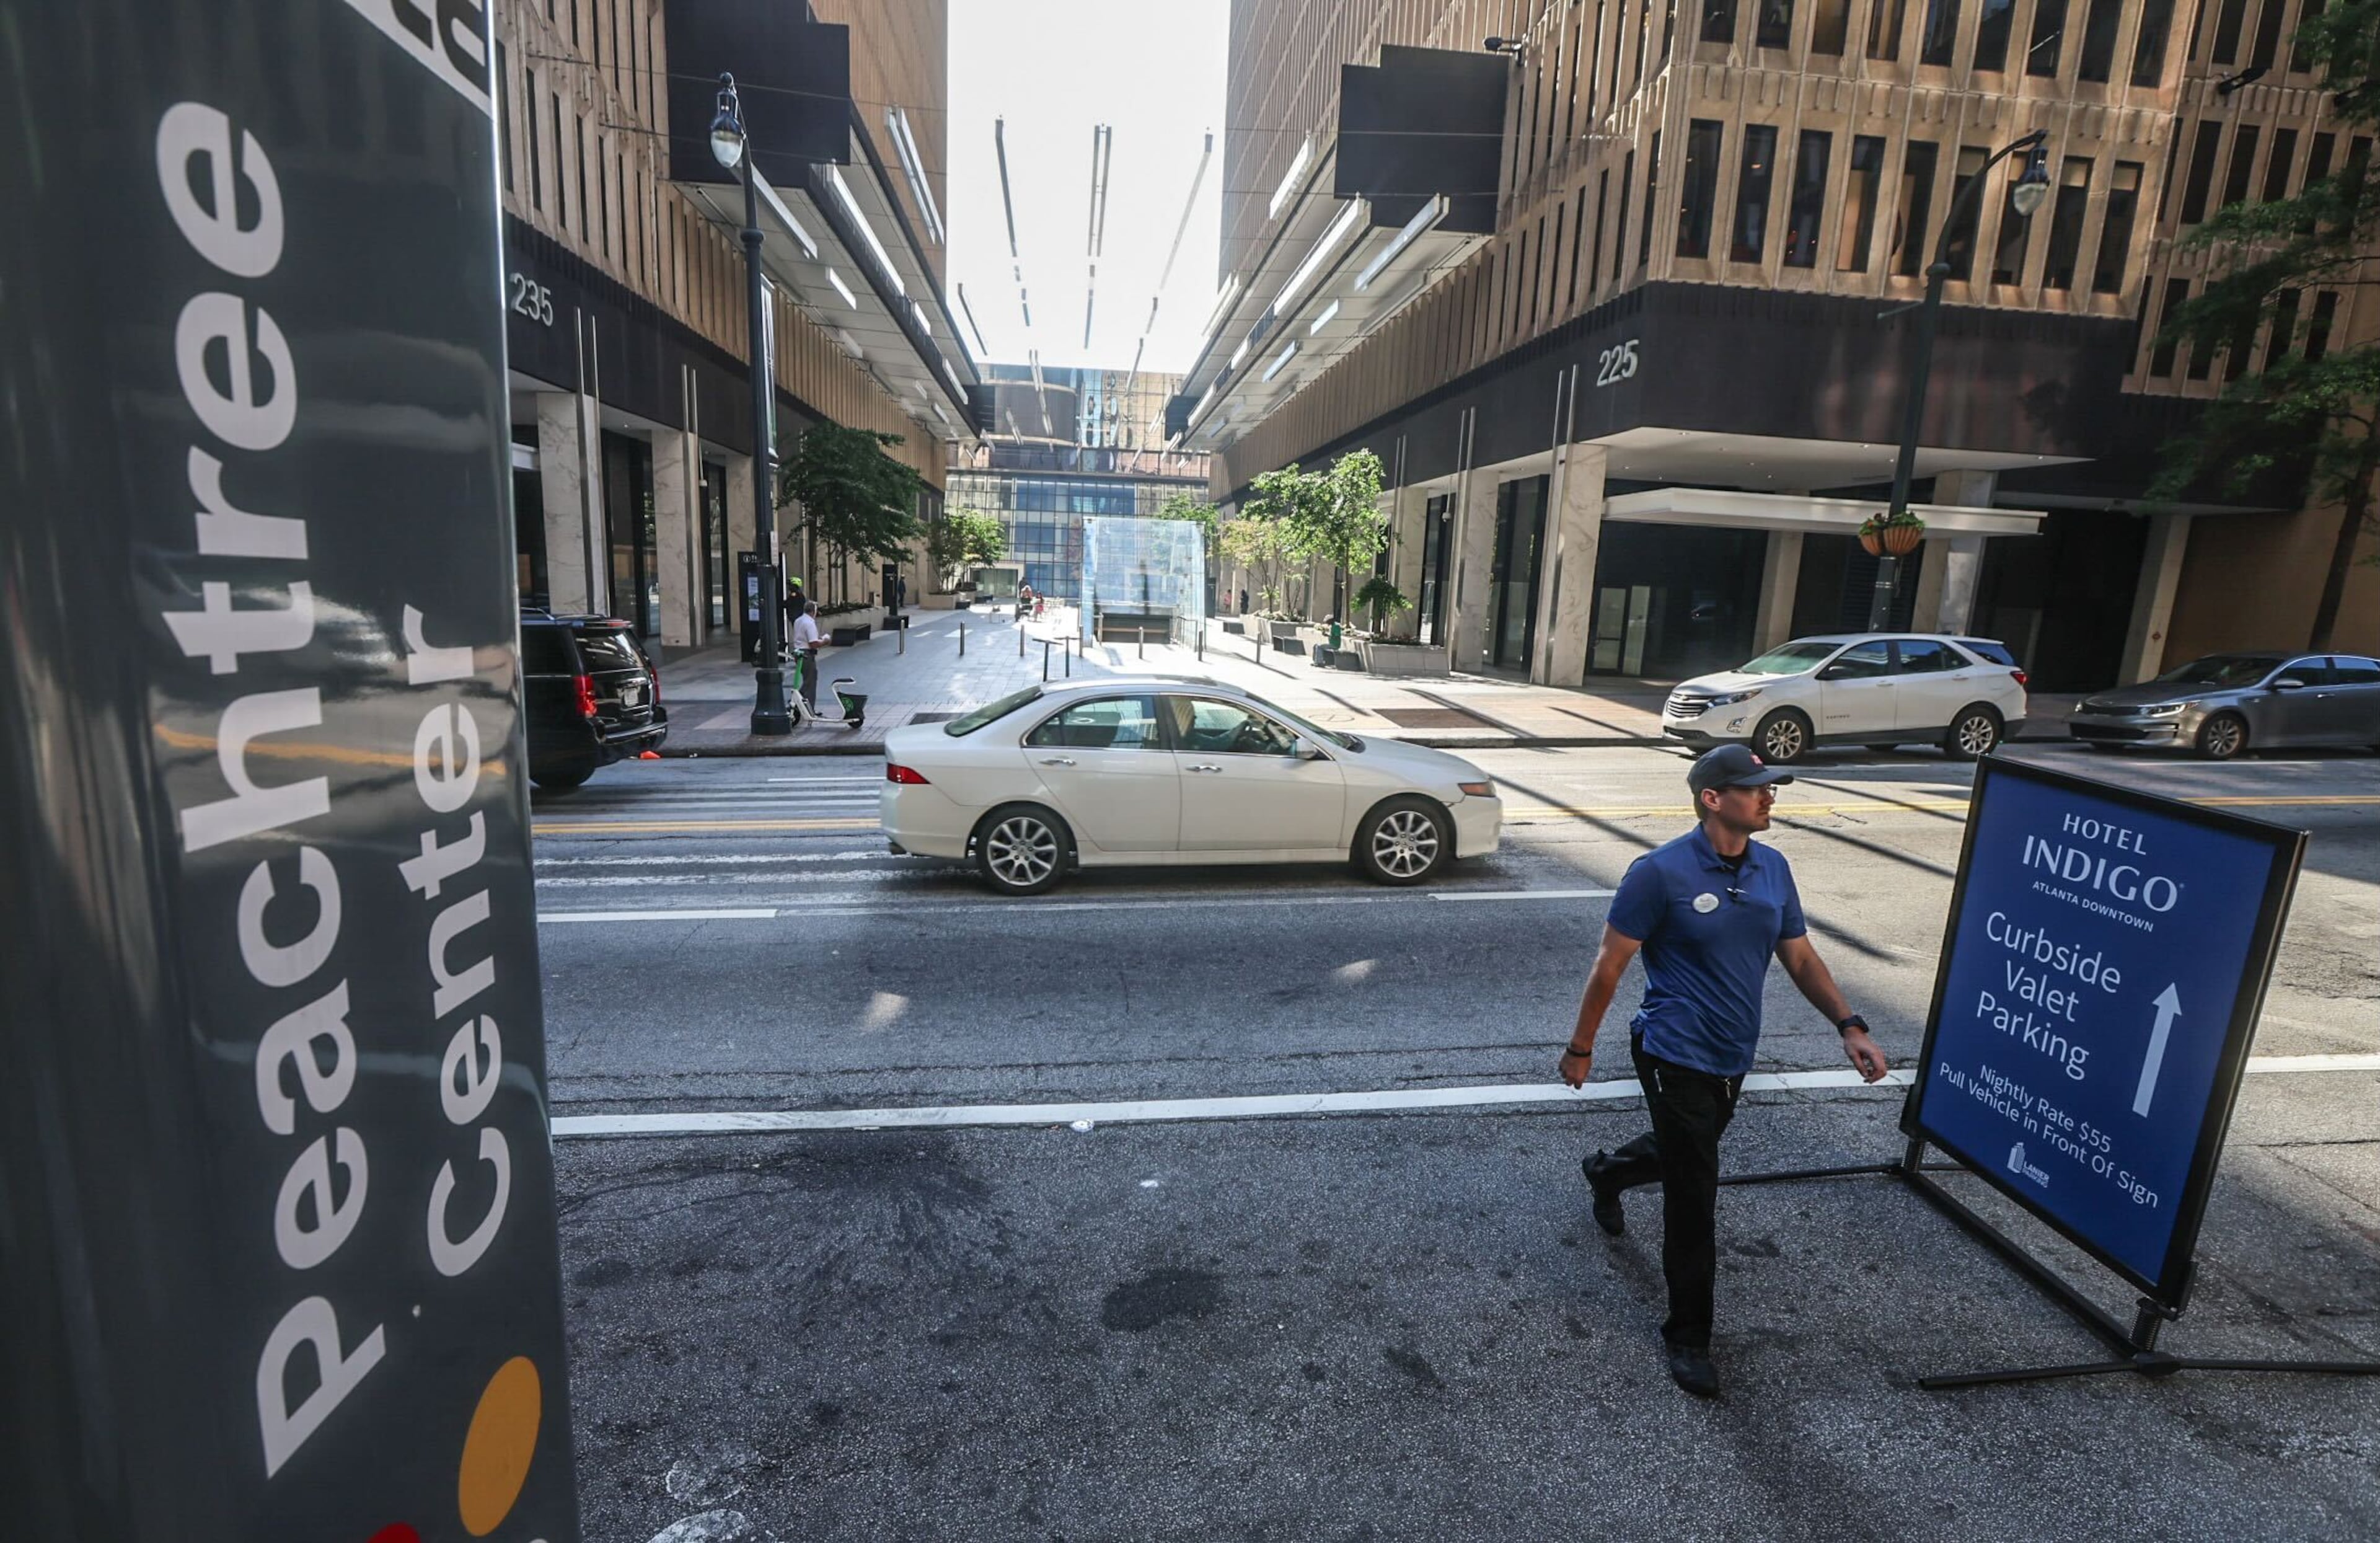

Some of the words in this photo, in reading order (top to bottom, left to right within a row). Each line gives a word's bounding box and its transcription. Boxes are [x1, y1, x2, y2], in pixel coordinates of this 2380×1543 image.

[509, 273, 553, 327] 235
[1597, 338, 1639, 386] 225
[156, 101, 386, 1480] Peachtree
[2022, 835, 2178, 912] INDIGO
[2063, 813, 2146, 856] HOTEL
[398, 604, 511, 1276] Center
[2032, 881, 2079, 905] ATLANTA
[2081, 899, 2154, 932] DOWNTOWN
[1986, 912, 2121, 993] Curbside
[2007, 960, 2079, 1022] Valet
[1977, 991, 2090, 1081] Parking
[1939, 1062, 1965, 1089] Pull
[1968, 1079, 2019, 1121] Vehicle
[2023, 1112, 2038, 1133] in
[2043, 1125, 2087, 1164] Front
[2092, 1155, 2115, 1178] Of
[2117, 1171, 2159, 1208] Sign
[1980, 1065, 2034, 1109] Nightly
[2037, 1098, 2074, 1131] Rate
[2078, 1121, 2112, 1153] $55
